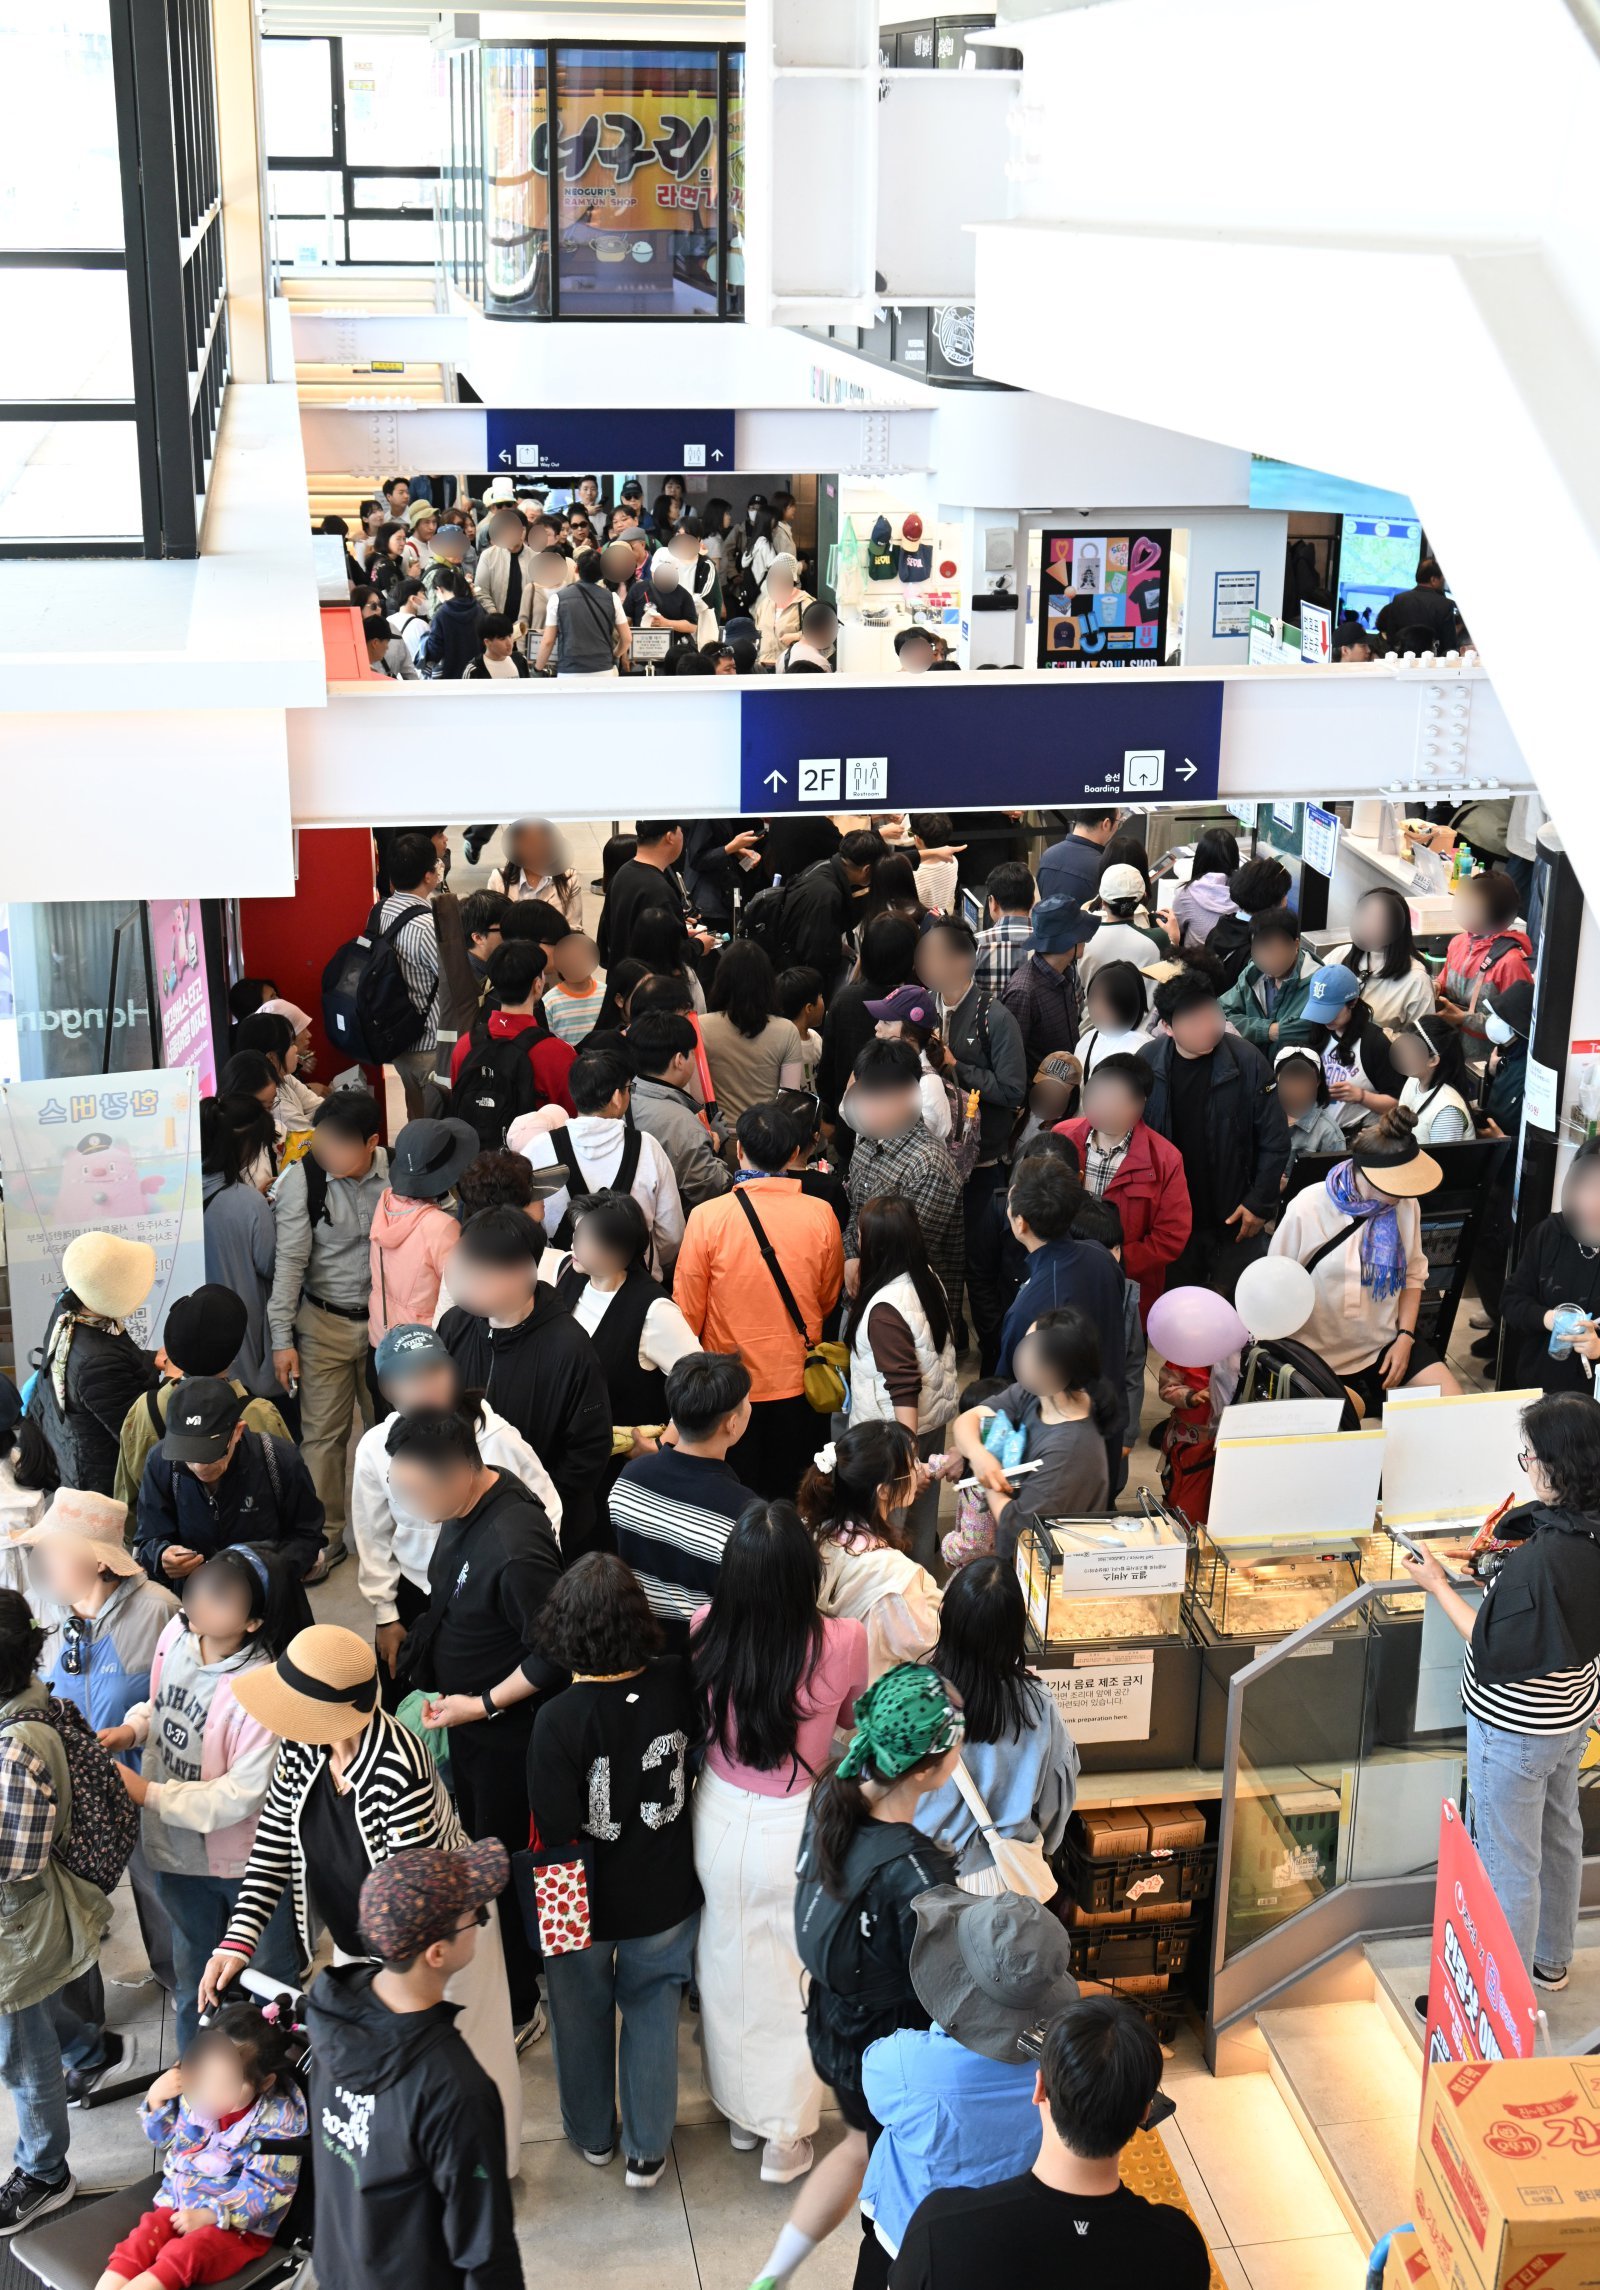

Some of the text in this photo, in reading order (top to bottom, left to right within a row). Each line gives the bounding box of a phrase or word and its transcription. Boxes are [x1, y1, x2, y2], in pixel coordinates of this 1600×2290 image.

[531, 111, 713, 183] 너구리
[564, 188, 616, 196] NEOGURI'S
[610, 198, 637, 207] SHOP
[804, 768, 836, 791] 2F
[1104, 773, 1121, 783] 승선
[1084, 785, 1120, 794] Boarding
[402, 1336, 427, 1349] YOUTH
[1102, 1571, 1148, 1581] 셀프 서비스
[1074, 1679, 1095, 1690] 음료
[1098, 1677, 1119, 1688] 제조
[1122, 1674, 1143, 1686] 금지
[1070, 1690, 1094, 1699] 조리대
[1096, 1689, 1112, 1698] 앞에
[1114, 1687, 1130, 1697] 공간
[1077, 1715, 1113, 1724] preparation
[580, 1729, 689, 1841] 13
[1146, 1876, 1161, 1888] 23
[1130, 1884, 1146, 1898] 23
[1444, 1918, 1480, 2036] 인증샷
[1497, 2140, 1535, 2153] 오뚜기
